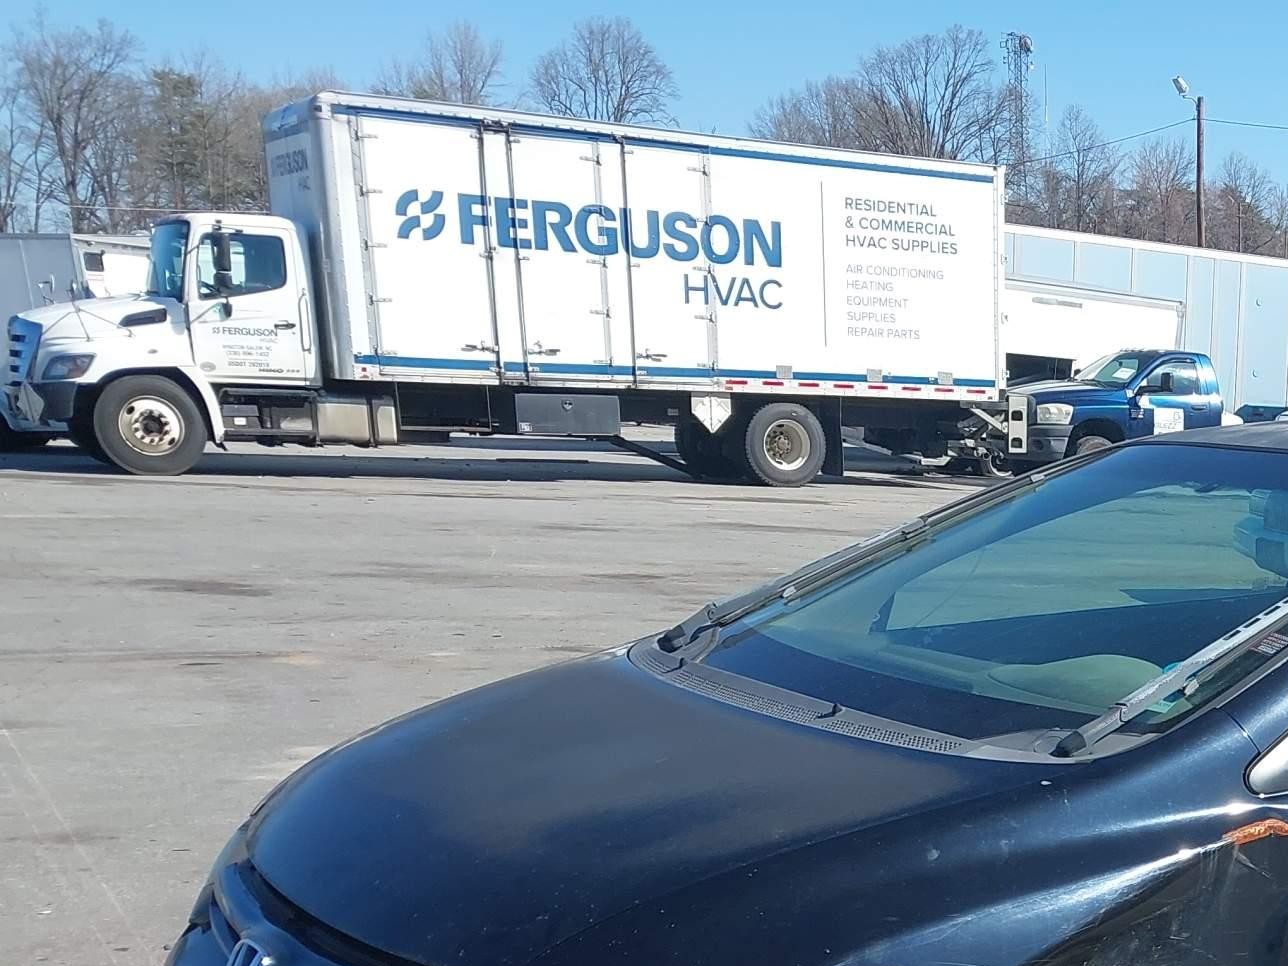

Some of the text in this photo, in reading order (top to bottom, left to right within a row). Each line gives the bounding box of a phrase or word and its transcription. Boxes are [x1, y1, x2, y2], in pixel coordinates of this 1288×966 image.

[845, 197, 937, 217] RESIDENTIAL
[458, 192, 782, 268] FERGUSON
[845, 215, 956, 237] & COMMERCIAL
[846, 234, 958, 255] HVAC SUPPLIES
[846, 264, 944, 280] AIR CONDITIONING
[684, 273, 783, 310] HVAC
[846, 280, 894, 292] HEATING
[846, 296, 908, 308] EQUIPMENT
[846, 311, 897, 323] SUPPLIES
[222, 327, 278, 336] FERGUSON
[847, 326, 920, 340] REPAIR PARTS
